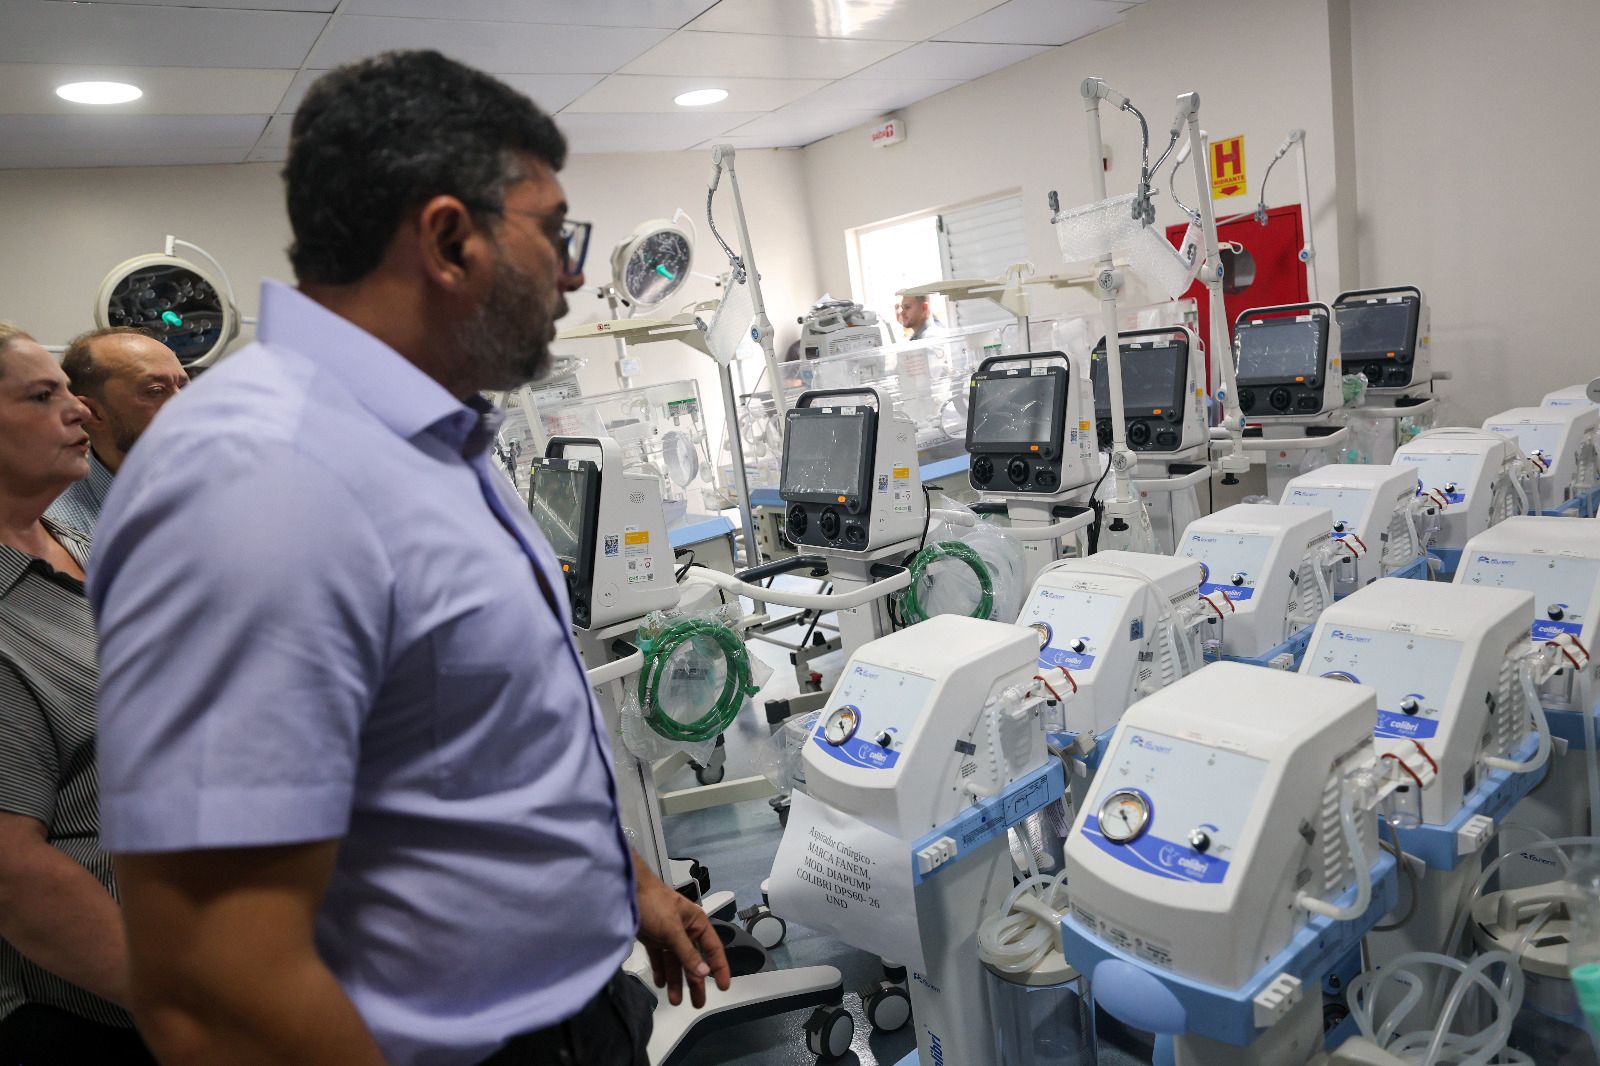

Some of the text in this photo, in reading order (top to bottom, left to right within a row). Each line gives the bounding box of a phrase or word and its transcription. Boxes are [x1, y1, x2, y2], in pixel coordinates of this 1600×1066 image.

[1215, 139, 1241, 178] H
[1213, 175, 1246, 186] HIDRANTE
[1390, 719, 1419, 731] colibri
[808, 826, 837, 848] Aspirador
[837, 841, 871, 863] Cirúrgico
[808, 841, 834, 864] MARCA
[796, 866, 832, 892] COLIBRI
[869, 897, 880, 909] 26
[804, 855, 871, 892] MOD. DIAPUMP
[826, 893, 848, 909] UND
